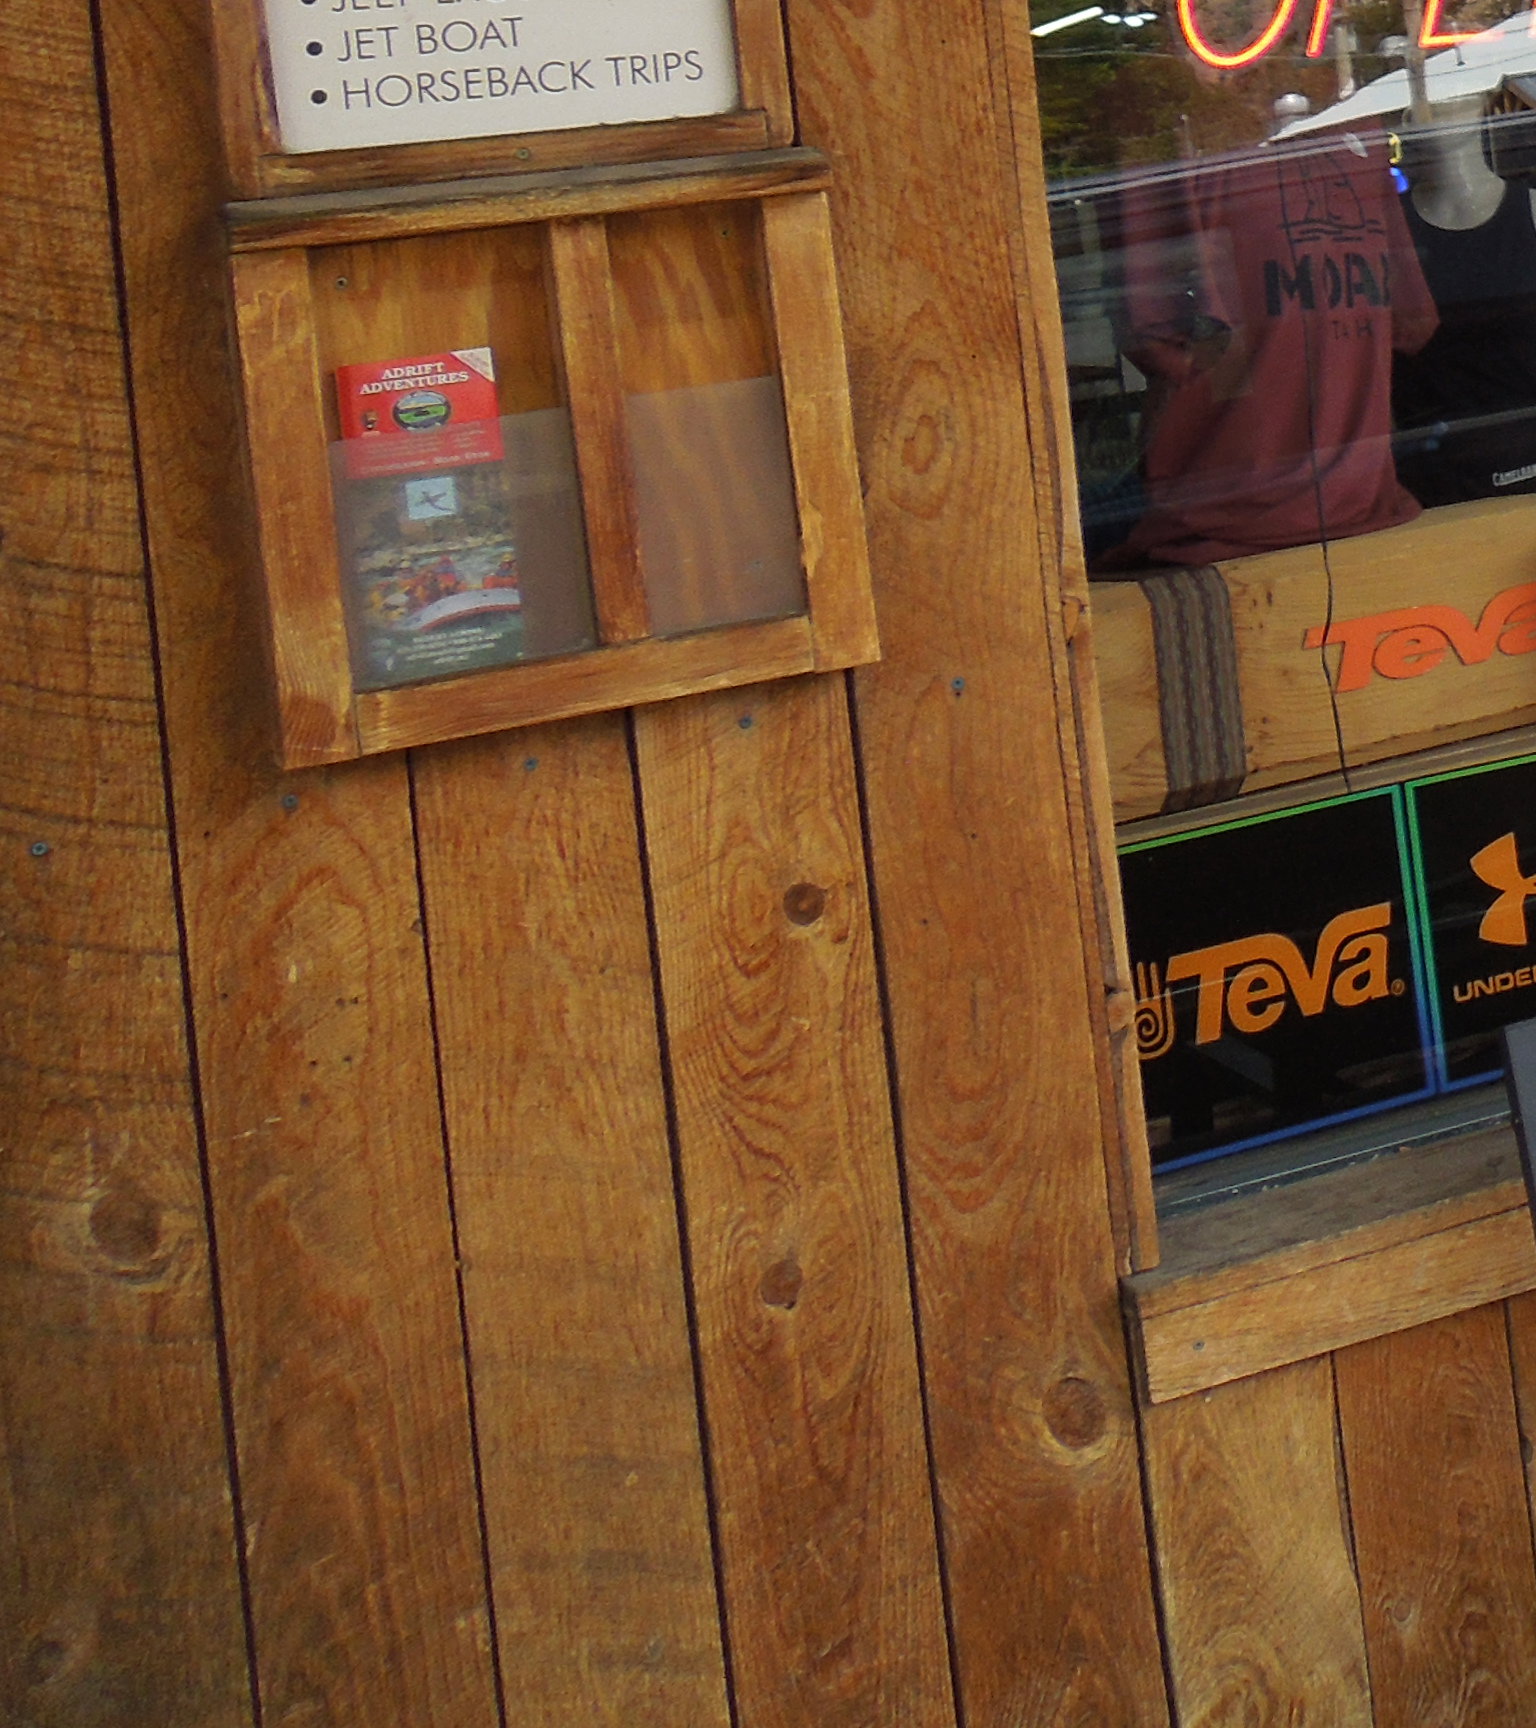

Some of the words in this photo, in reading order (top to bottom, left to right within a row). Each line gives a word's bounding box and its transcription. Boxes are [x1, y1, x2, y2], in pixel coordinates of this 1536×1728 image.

[337, 26, 399, 63] JET
[416, 16, 524, 55] BOAT
[343, 58, 596, 110] HORSEBACK
[605, 50, 704, 88] TRIPS
[359, 370, 470, 395] ADVENTURES
[381, 361, 445, 381] ADRIFT
[1164, 902, 1393, 1046] Teva
